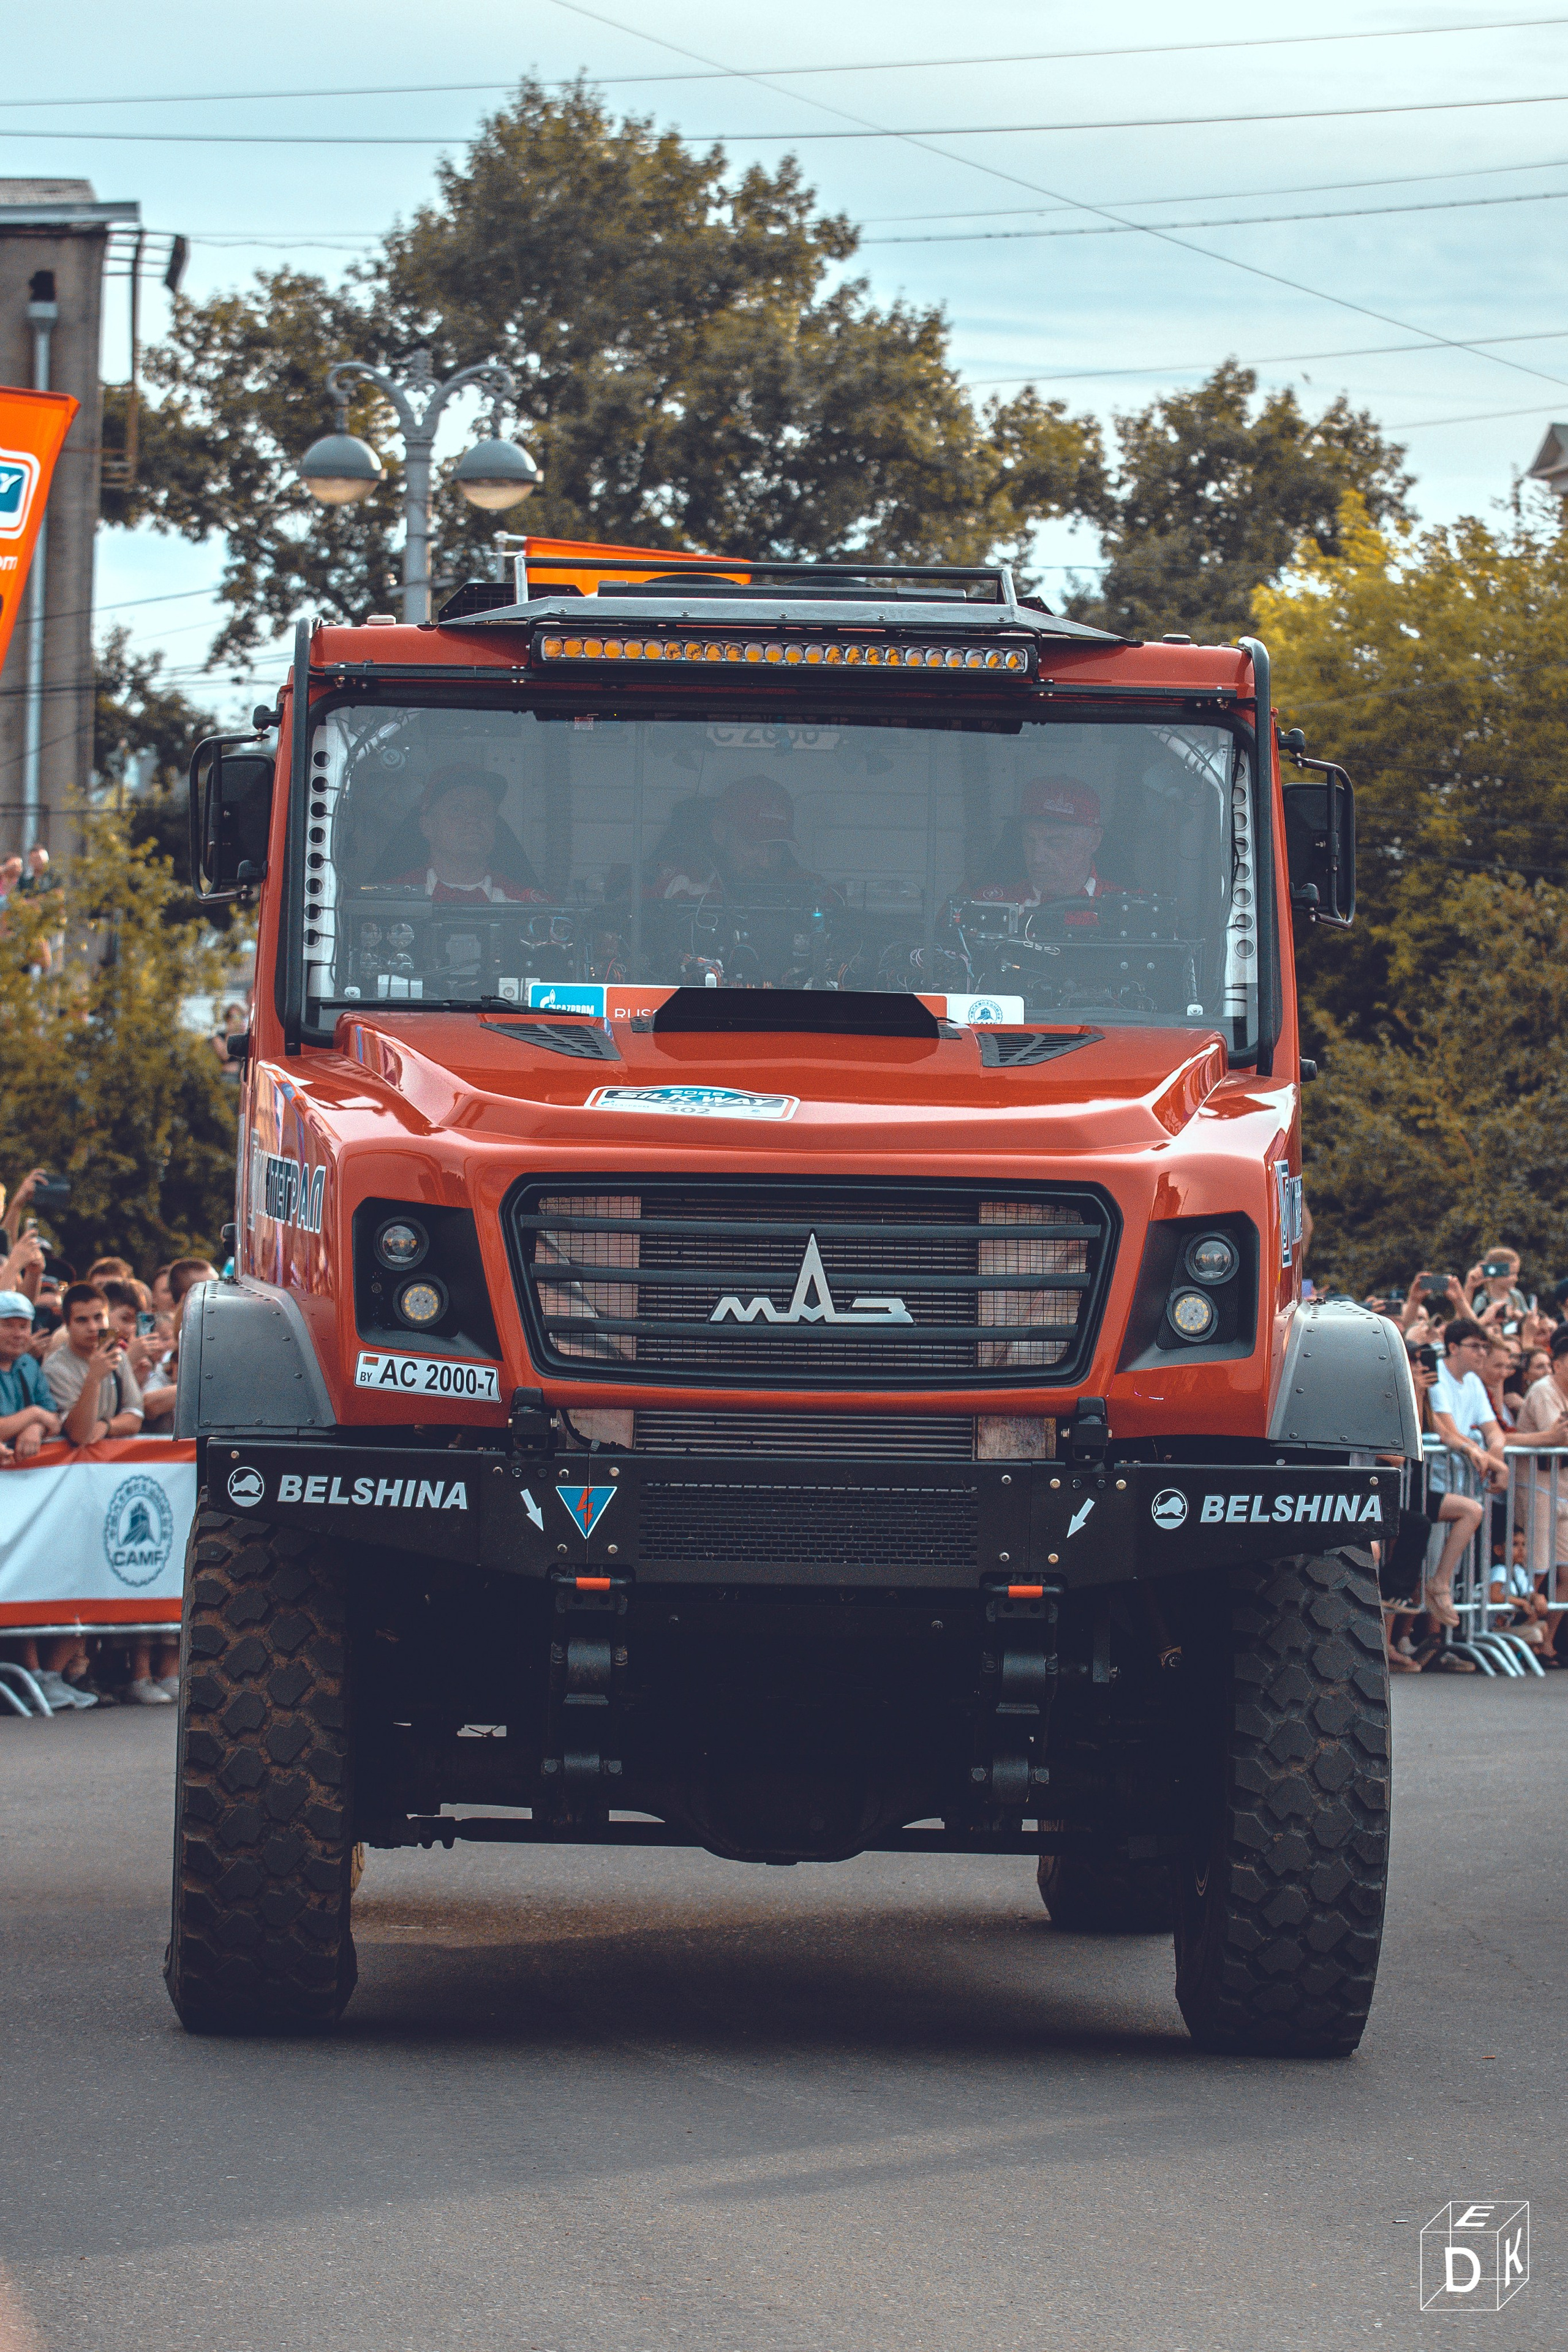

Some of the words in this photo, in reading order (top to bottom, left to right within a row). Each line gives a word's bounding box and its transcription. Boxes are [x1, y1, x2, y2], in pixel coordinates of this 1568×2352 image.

[613, 1091, 696, 1102] SILK
[702, 1096, 777, 1106] WAY
[665, 1106, 710, 1114] 302
[360, 1371, 372, 1382] BY
[379, 1359, 418, 1388] AC
[424, 1363, 495, 1396] 2000-7
[277, 1474, 468, 1510] BELSHINA
[1200, 1495, 1382, 1523] BELSHINA
[113, 1550, 164, 1566] CAMF
